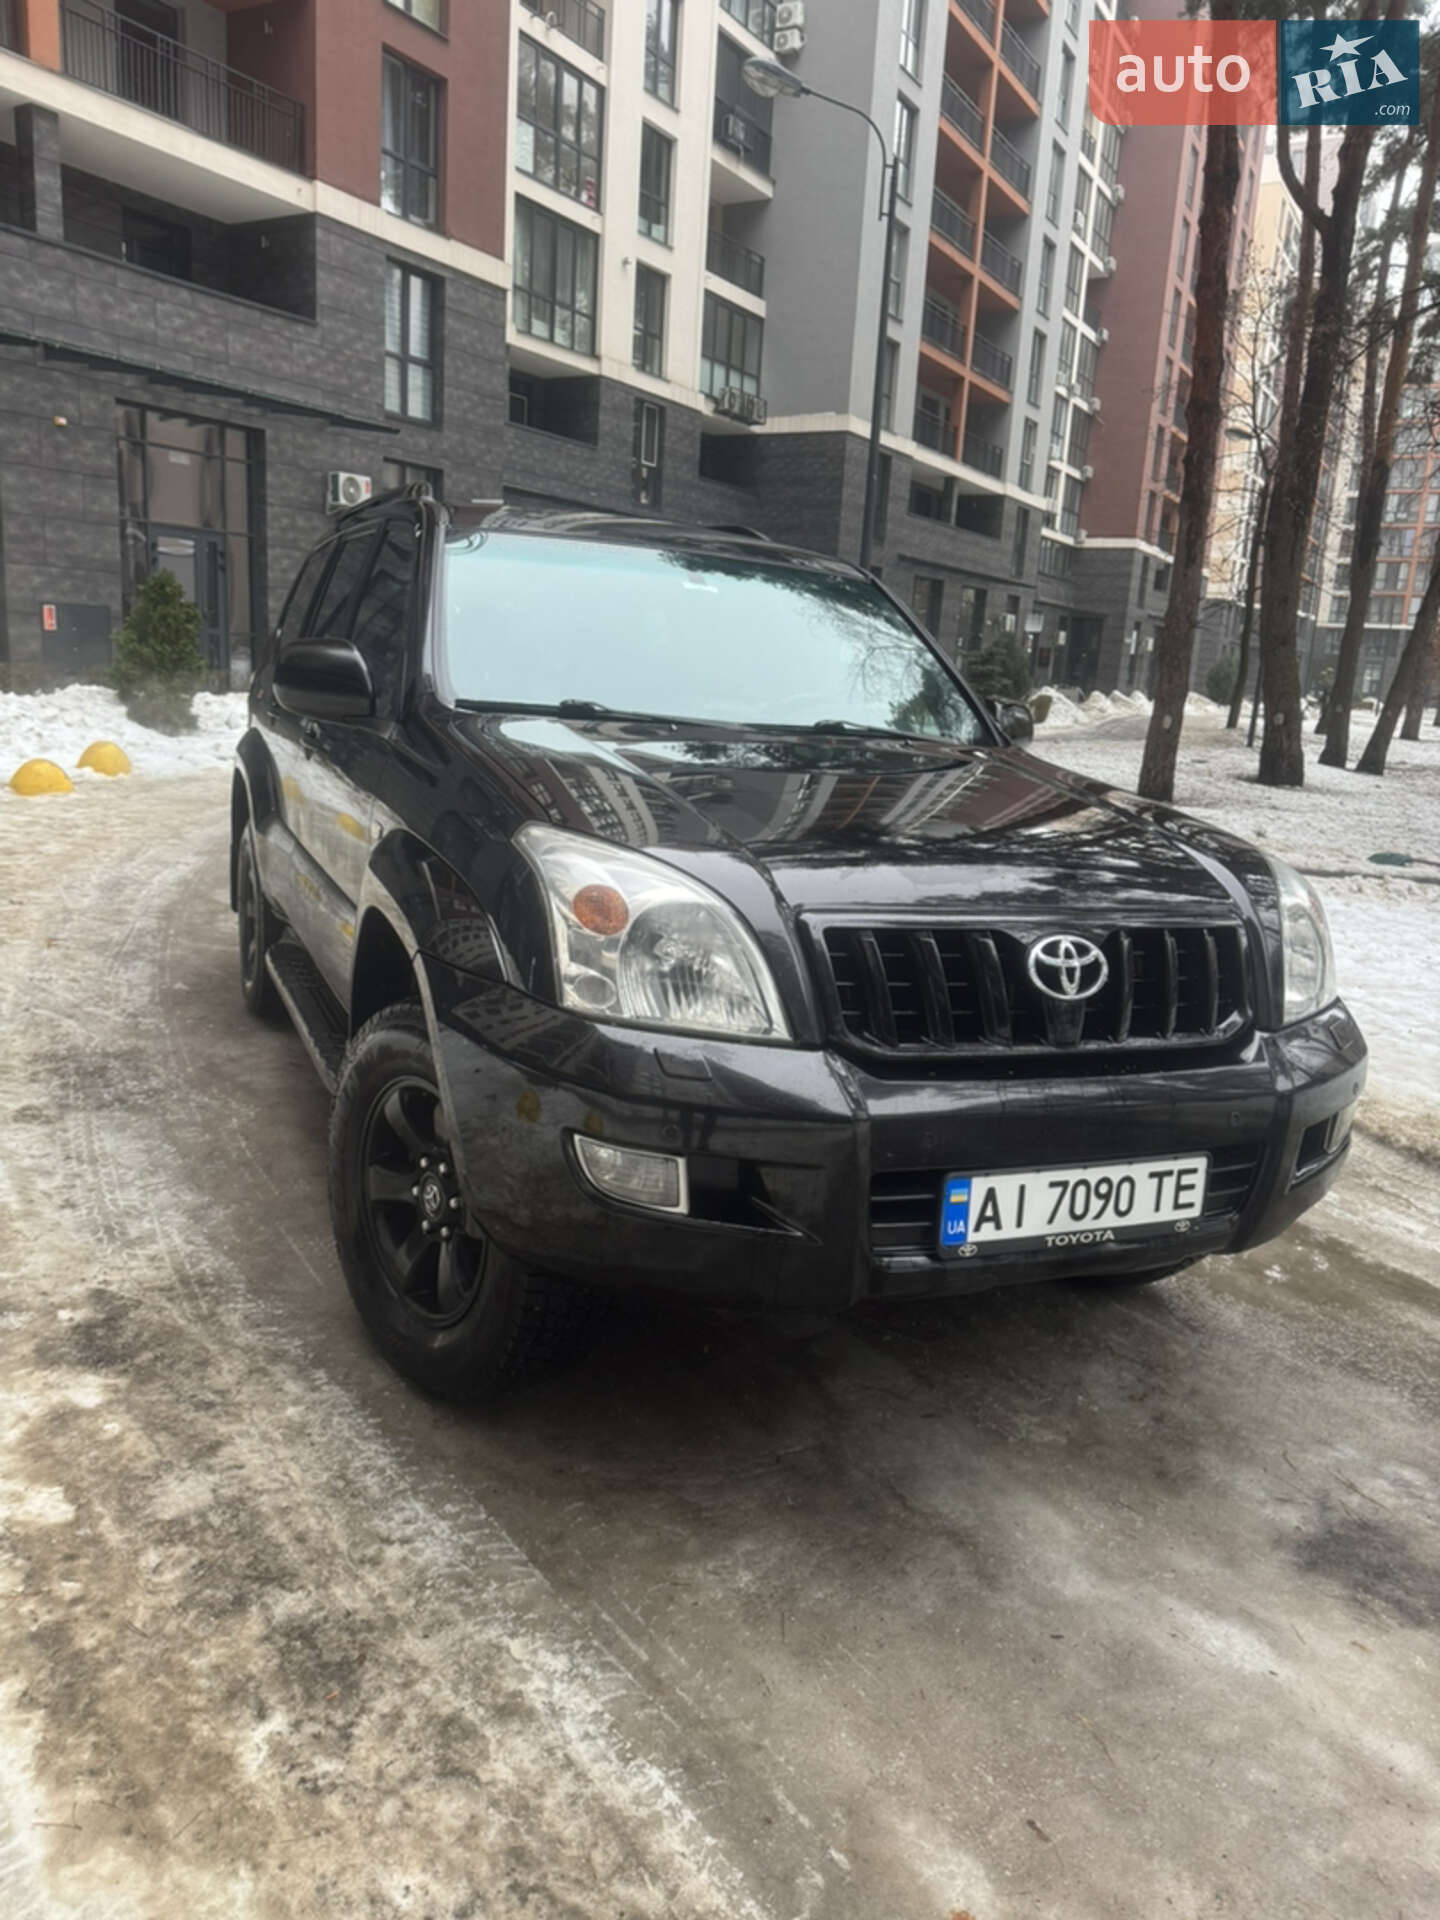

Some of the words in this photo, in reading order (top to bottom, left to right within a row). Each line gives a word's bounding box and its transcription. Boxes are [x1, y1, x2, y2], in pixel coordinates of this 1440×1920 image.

[1047, 1175, 1136, 1225] 7090
[1148, 1168, 1198, 1213] TE
[947, 1221, 966, 1235] UA
[1045, 1230, 1115, 1247] TOYOTA
